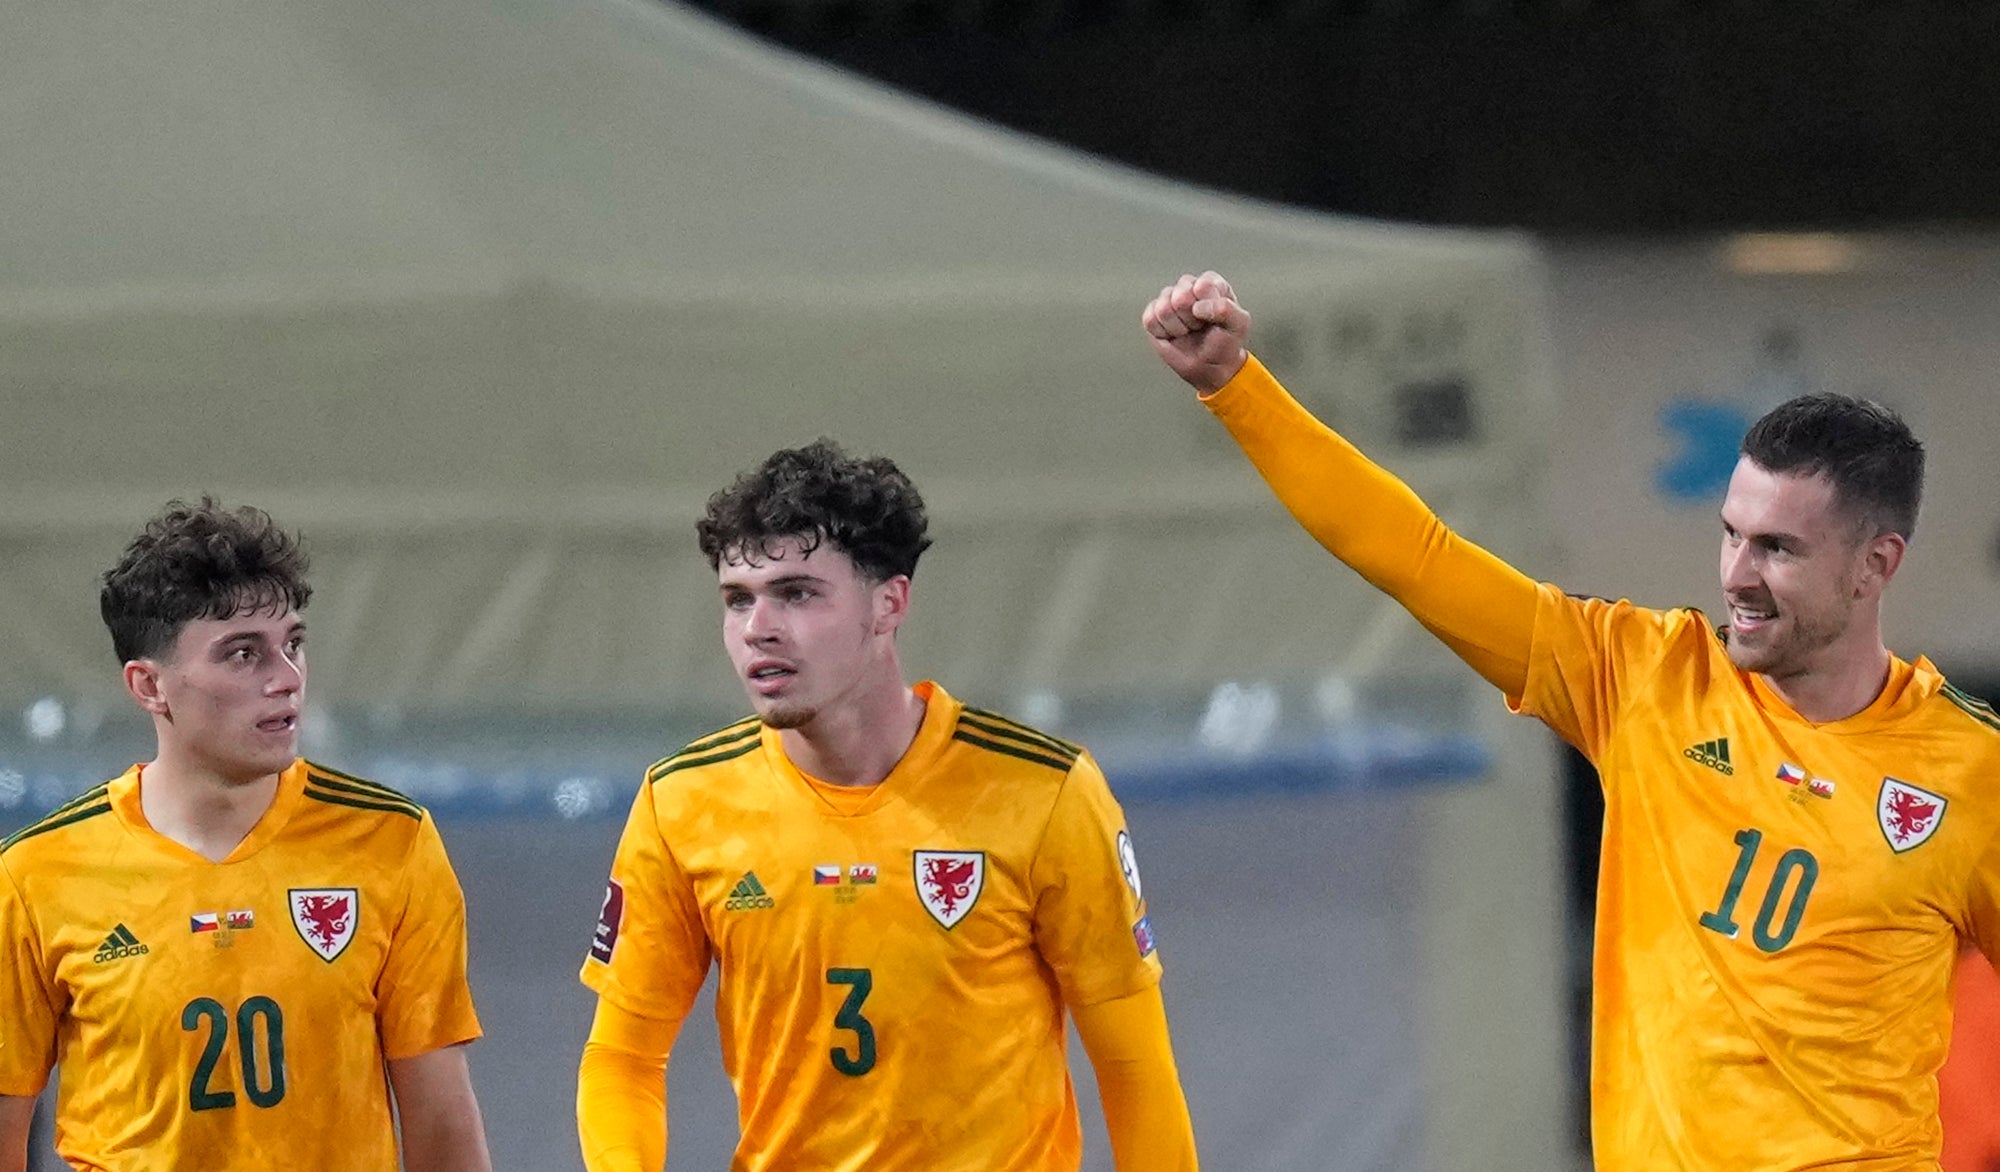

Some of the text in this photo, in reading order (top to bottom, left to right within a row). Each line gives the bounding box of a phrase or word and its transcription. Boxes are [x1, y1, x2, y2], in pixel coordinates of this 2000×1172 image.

[1683, 748, 1734, 776] adidas
[725, 896, 775, 911] adidas
[1699, 828, 1819, 954] 10
[94, 944, 149, 963] adidas
[182, 996, 286, 1112] 20
[826, 967, 877, 1076] 3
